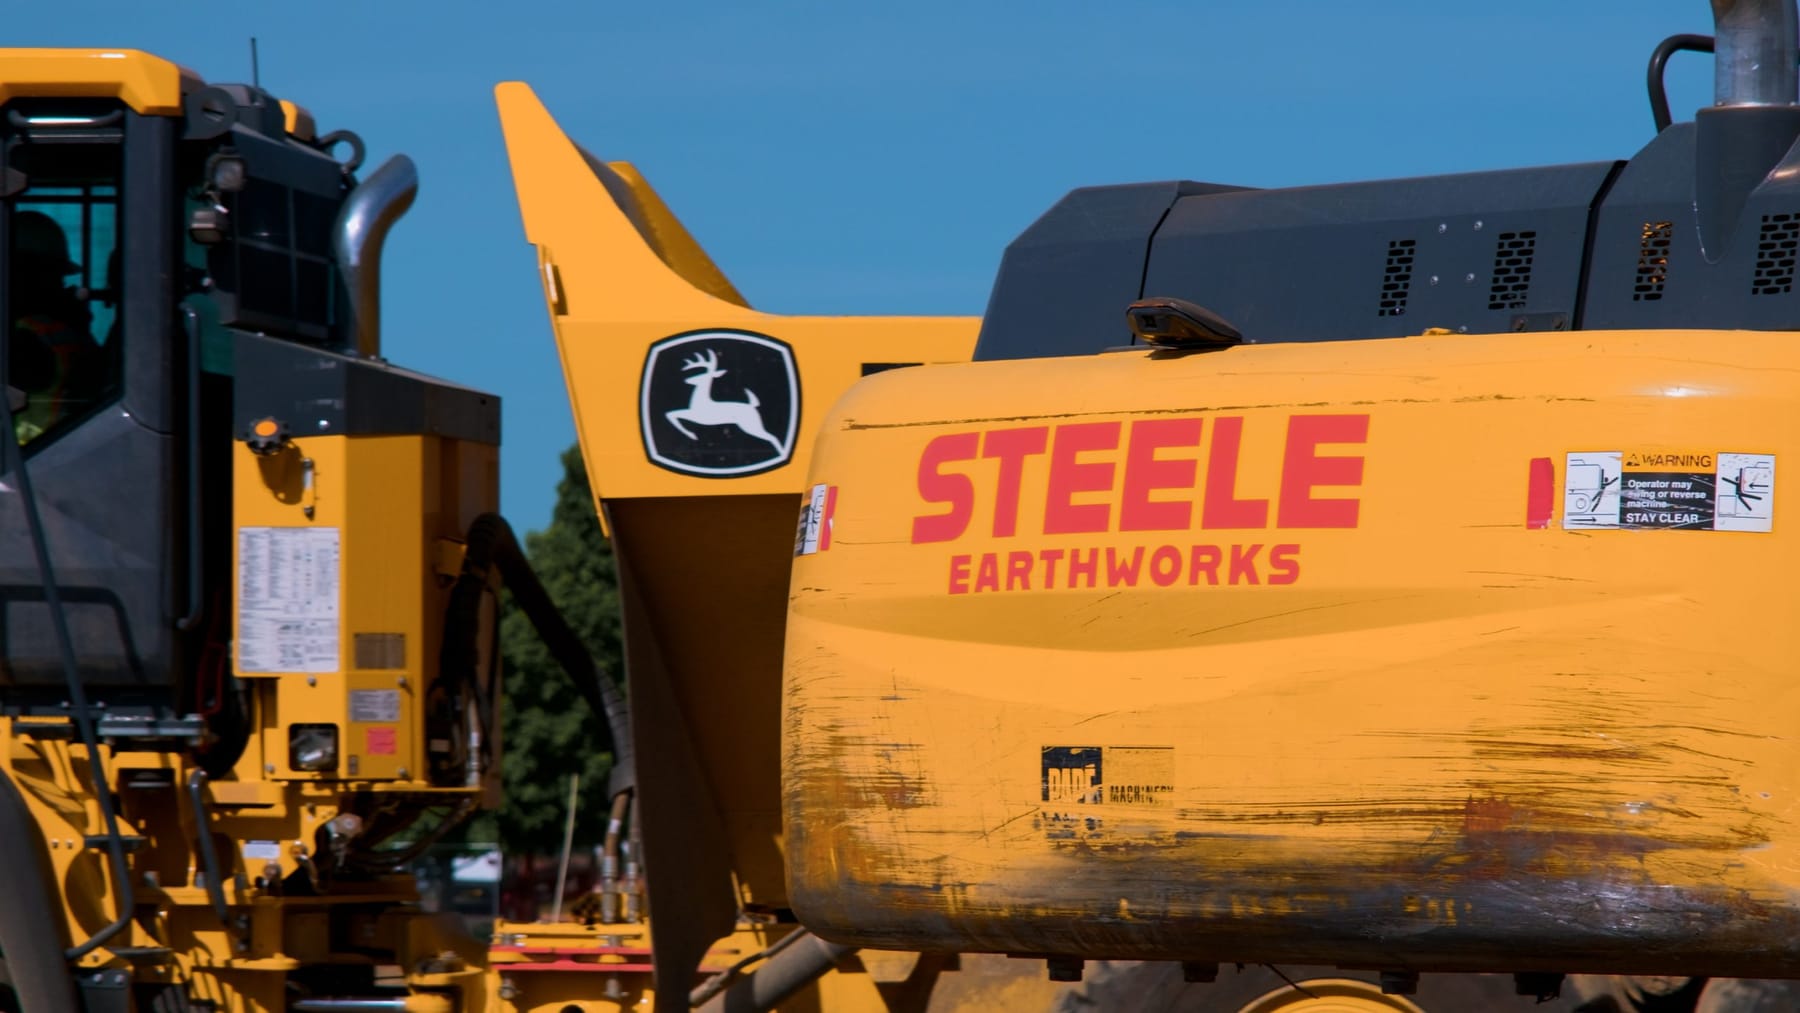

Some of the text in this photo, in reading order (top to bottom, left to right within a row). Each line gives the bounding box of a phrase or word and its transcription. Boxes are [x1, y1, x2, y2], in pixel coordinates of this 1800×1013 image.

[1642, 454, 1712, 468] WARNING
[911, 414, 1370, 545] STEELE
[1627, 479, 1693, 491] Operator may
[1657, 490, 1668, 498] or
[1669, 490, 1707, 499] reverse
[1626, 500, 1667, 508] machine
[1626, 513, 1698, 523] STAY CLEAR
[948, 543, 1301, 595] EARTHWORKS
